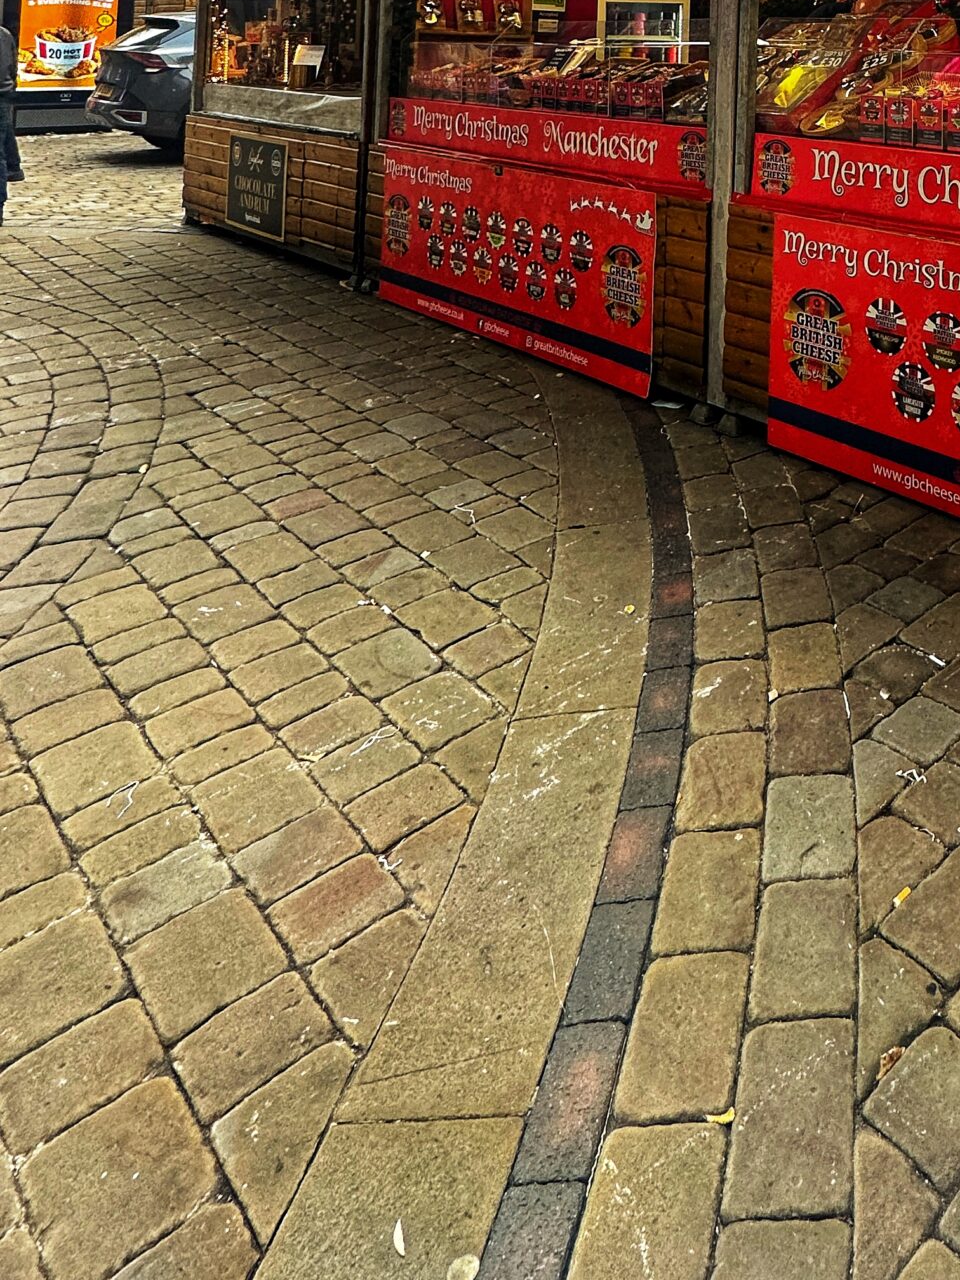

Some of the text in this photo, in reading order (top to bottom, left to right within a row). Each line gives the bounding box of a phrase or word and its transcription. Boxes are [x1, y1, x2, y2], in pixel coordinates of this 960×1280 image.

[48, 49, 62, 60] 20
[861, 56, 888, 71] £25
[413, 105, 658, 166] Merry Christmas Manchester
[761, 161, 791, 173] BRITISH
[764, 153, 789, 165] GREAT
[385, 157, 473, 194] Merry Christmas
[762, 170, 790, 181] CHEESE
[811, 148, 910, 208] Merry
[234, 175, 277, 199] CHOCOLATE
[782, 229, 858, 277] Merry
[609, 265, 638, 281] GREAT
[605, 275, 641, 295] BRITISH
[606, 288, 640, 307] CHEESE
[483, 321, 510, 338] gbcheese
[796, 311, 839, 336] GREAT
[791, 324, 843, 351] BRITISH
[533, 339, 588, 367] greatbritishcheese
[792, 340, 841, 366] CHEESE
